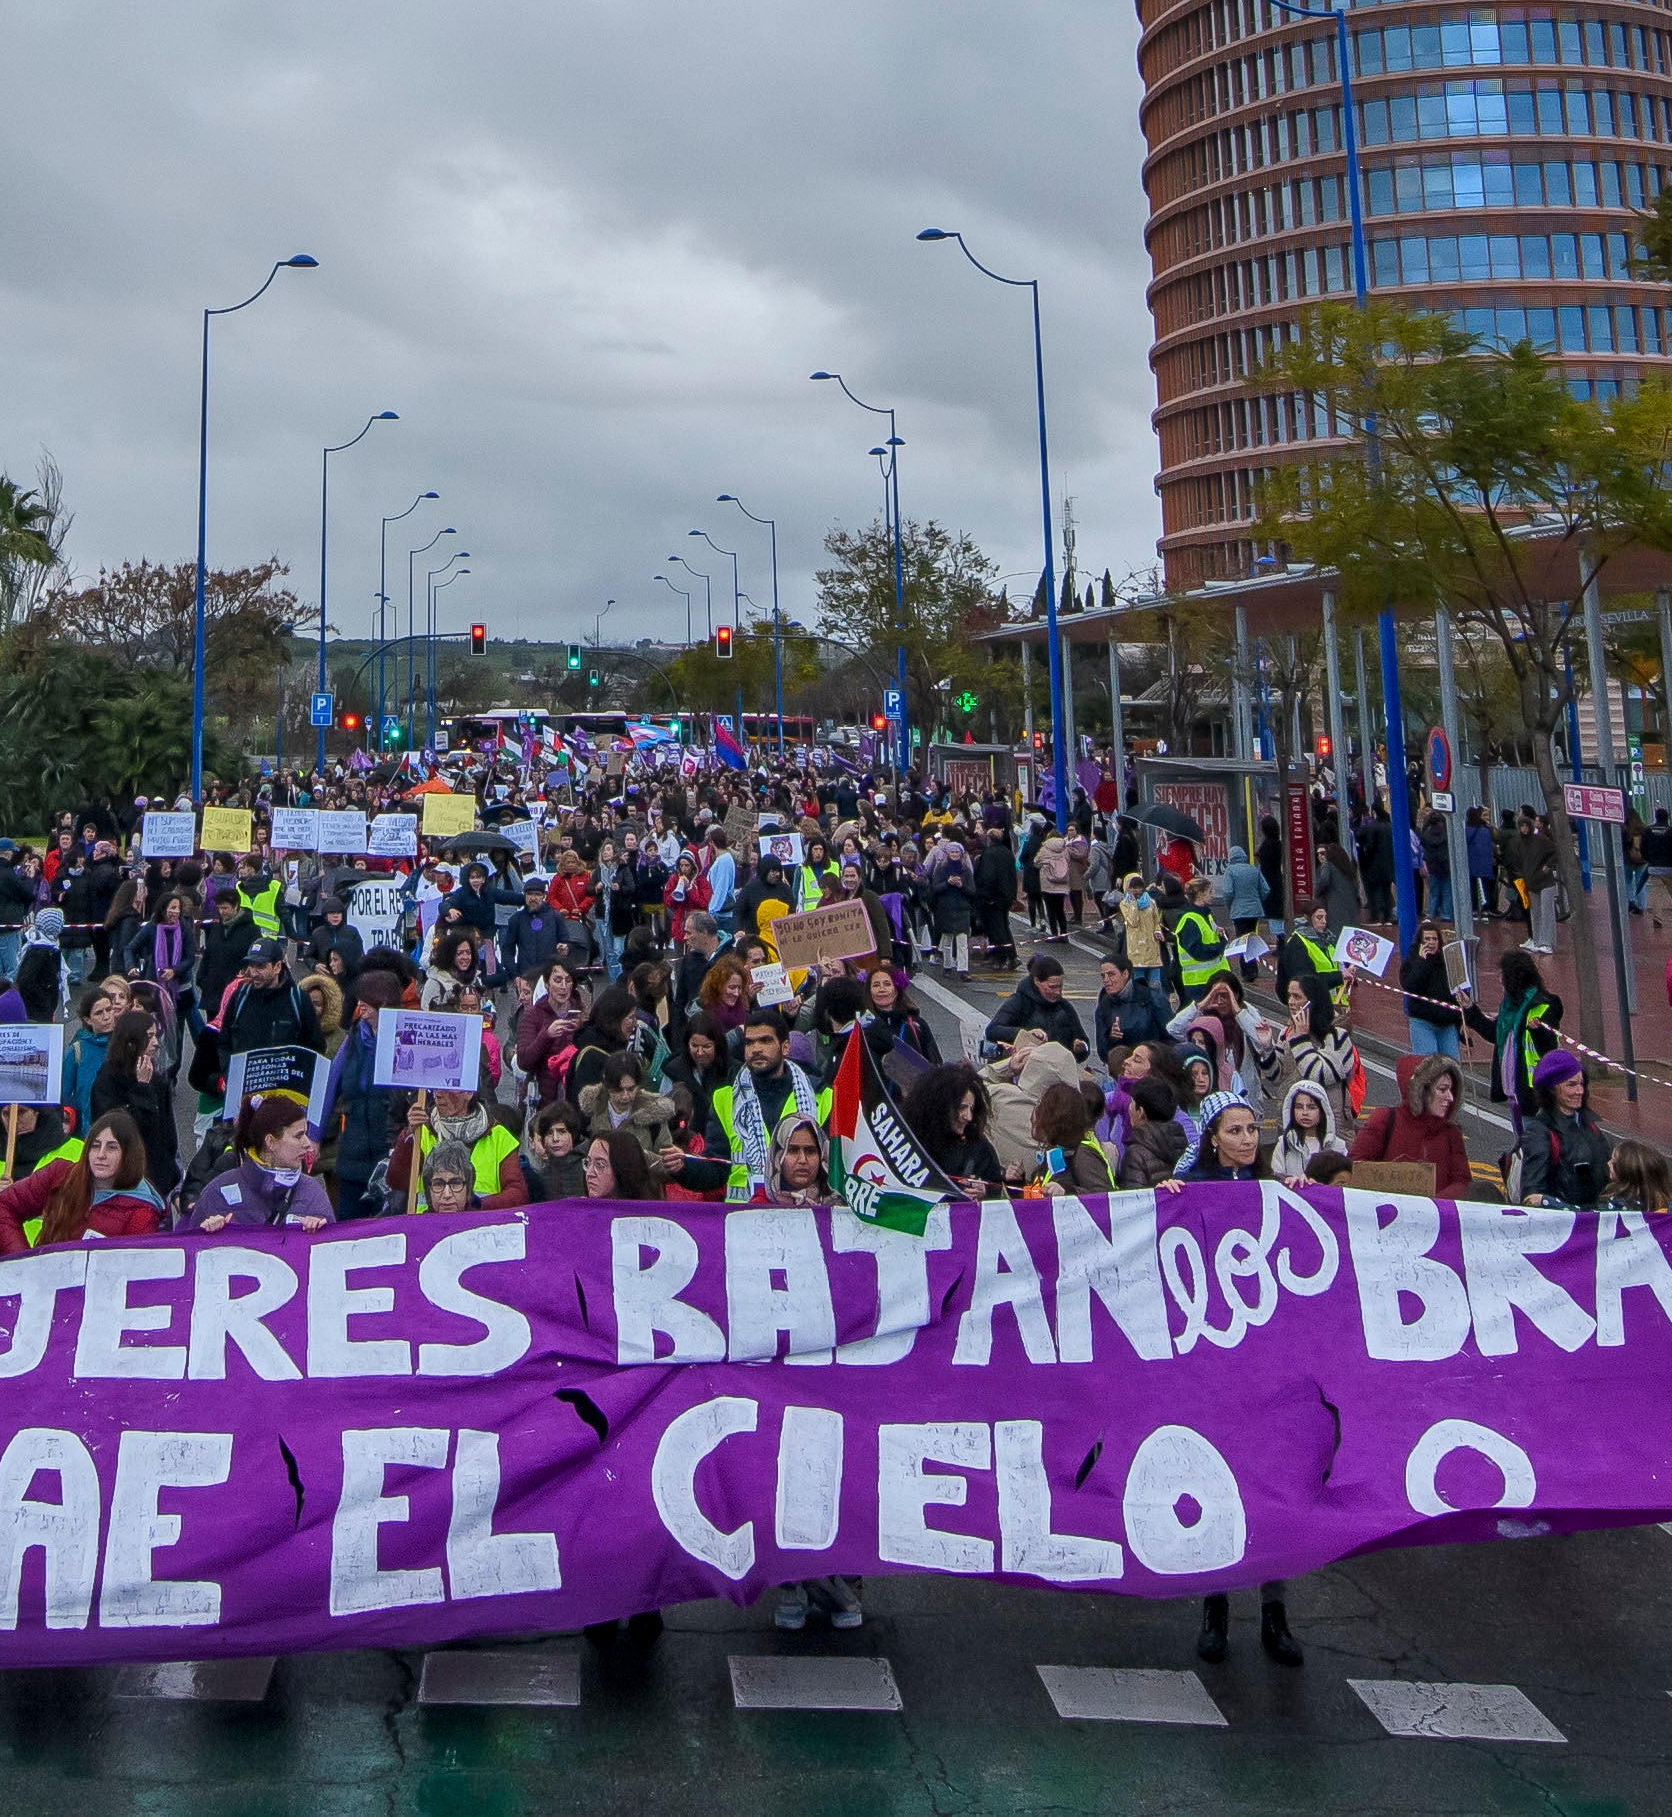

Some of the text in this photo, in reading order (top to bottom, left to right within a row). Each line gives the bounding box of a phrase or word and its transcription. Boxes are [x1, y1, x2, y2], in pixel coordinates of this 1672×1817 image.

[317, 698, 326, 710] P
[889, 692, 900, 707] P
[1155, 785, 1225, 803] SIEMPRE HAY
[1291, 796, 1307, 894] PUERTA TRIANA
[351, 887, 372, 916] POR
[374, 888, 387, 915] EL
[403, 1022, 457, 1033] PRECARIZADO
[425, 1031, 439, 1039] LAS
[247, 1062, 287, 1072] PERSONAS
[248, 1057, 268, 1066] PARA
[270, 1055, 296, 1063] TODAS
[246, 1068, 304, 1078] MIGRANTES DEL
[246, 1075, 289, 1085] TERRITORIO
[871, 1102, 930, 1188] SAHARA
[1158, 1179, 1340, 1355] los
[329, 1428, 563, 1618] EL
[651, 1395, 1248, 1582] CIELO
